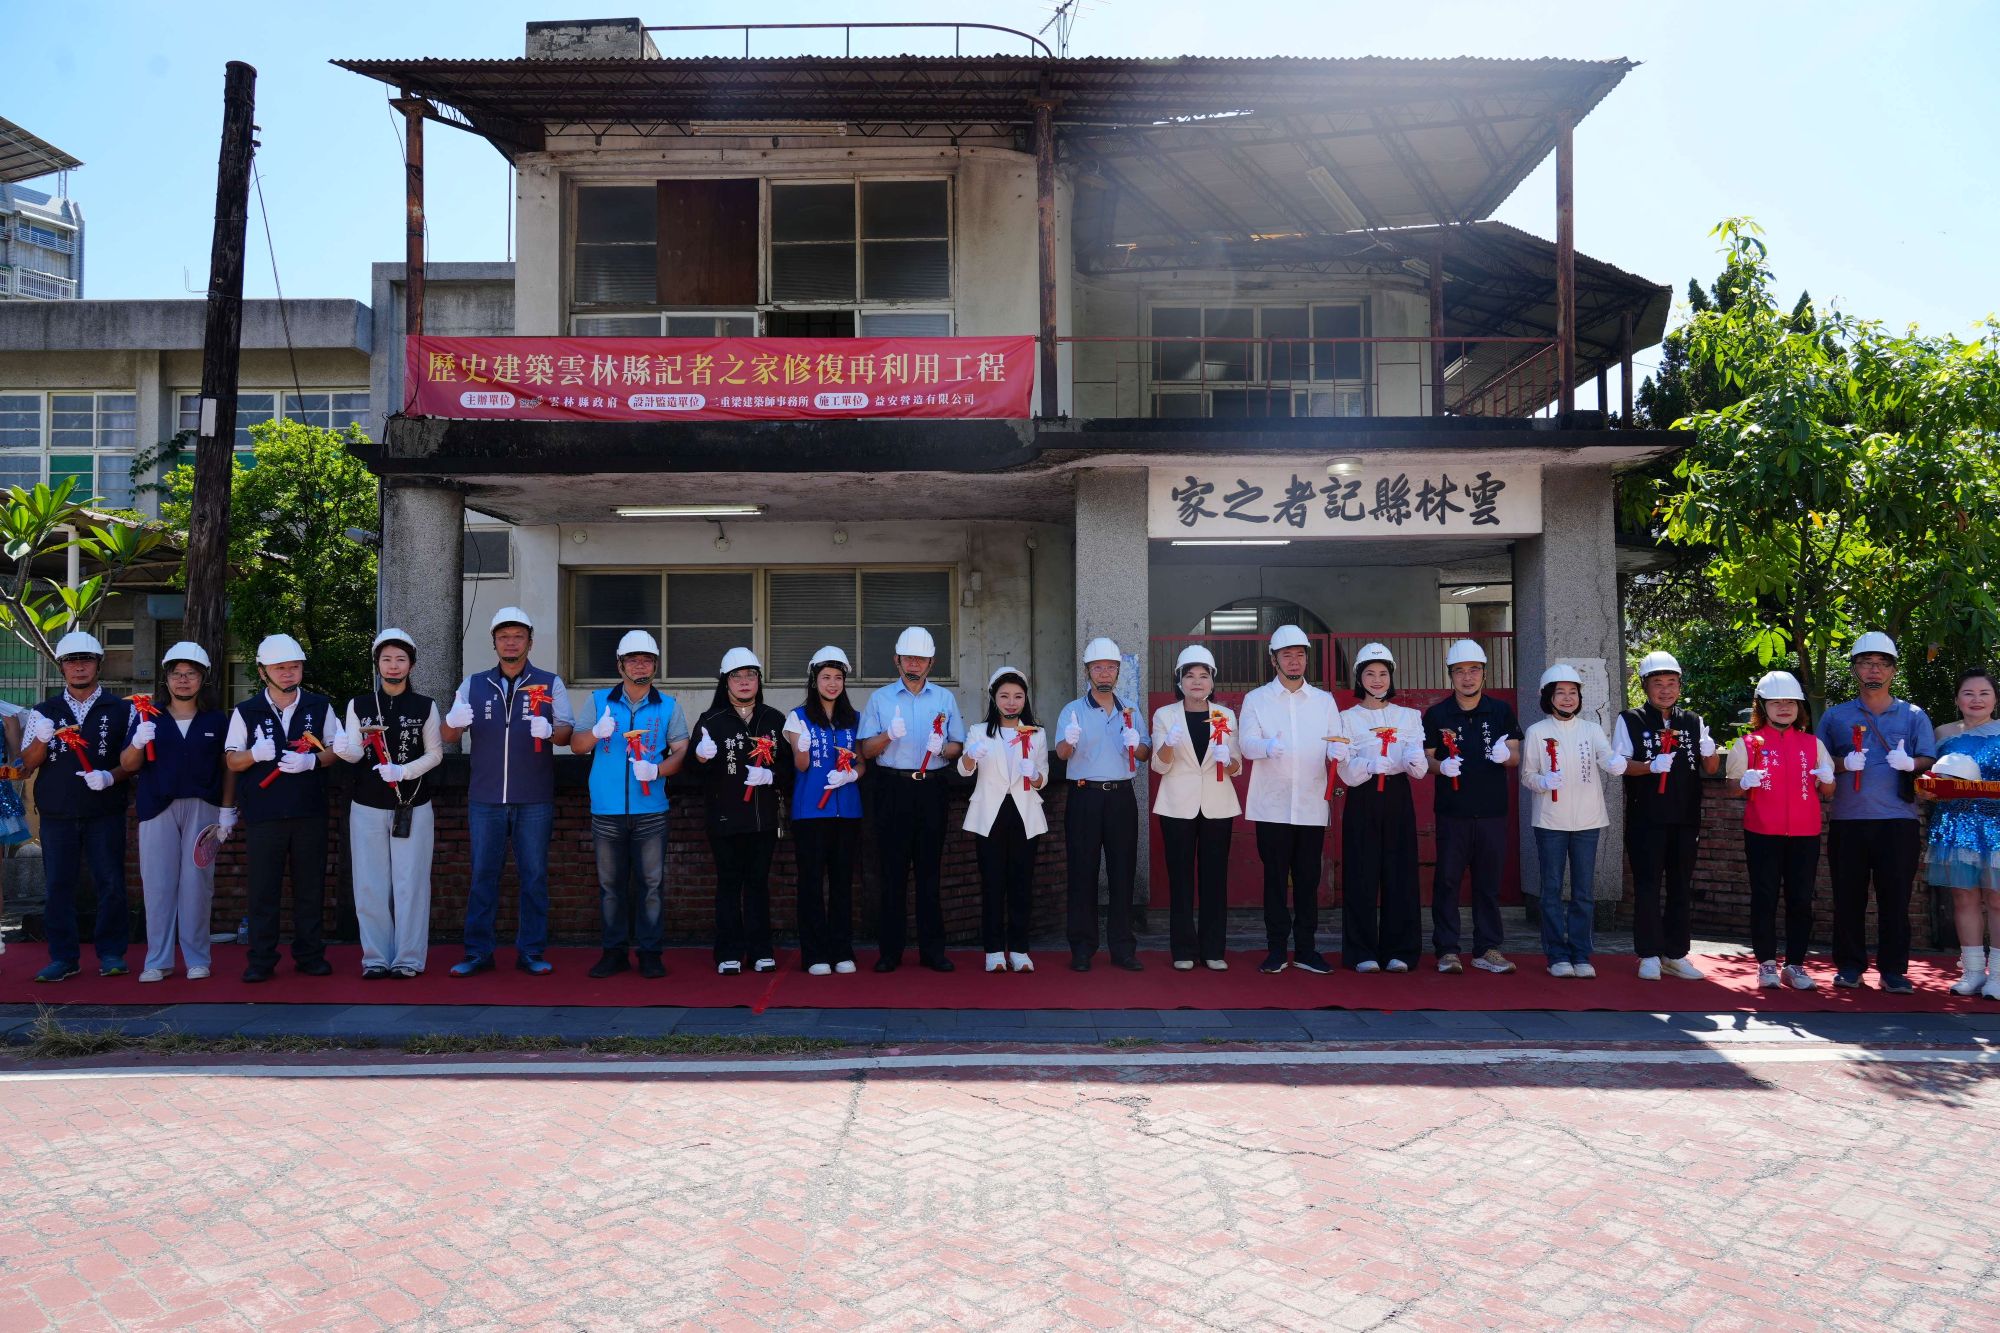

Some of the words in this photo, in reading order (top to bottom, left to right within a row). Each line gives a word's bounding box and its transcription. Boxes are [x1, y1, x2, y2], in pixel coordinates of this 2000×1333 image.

[427, 351, 1006, 386] 歷史建築雲林縣記者之家修復再利用工程
[467, 394, 510, 406] 主辦單位
[548, 396, 617, 408] 雲林縣政府
[633, 395, 701, 408] 設計監造單位
[818, 395, 863, 407] 施工單位
[874, 393, 975, 407] 益安營造有限公司
[98, 715, 109, 757] 斗六市公所
[1770, 750, 1779, 766] 代表
[1799, 750, 1809, 801] 斗六市民代表會
